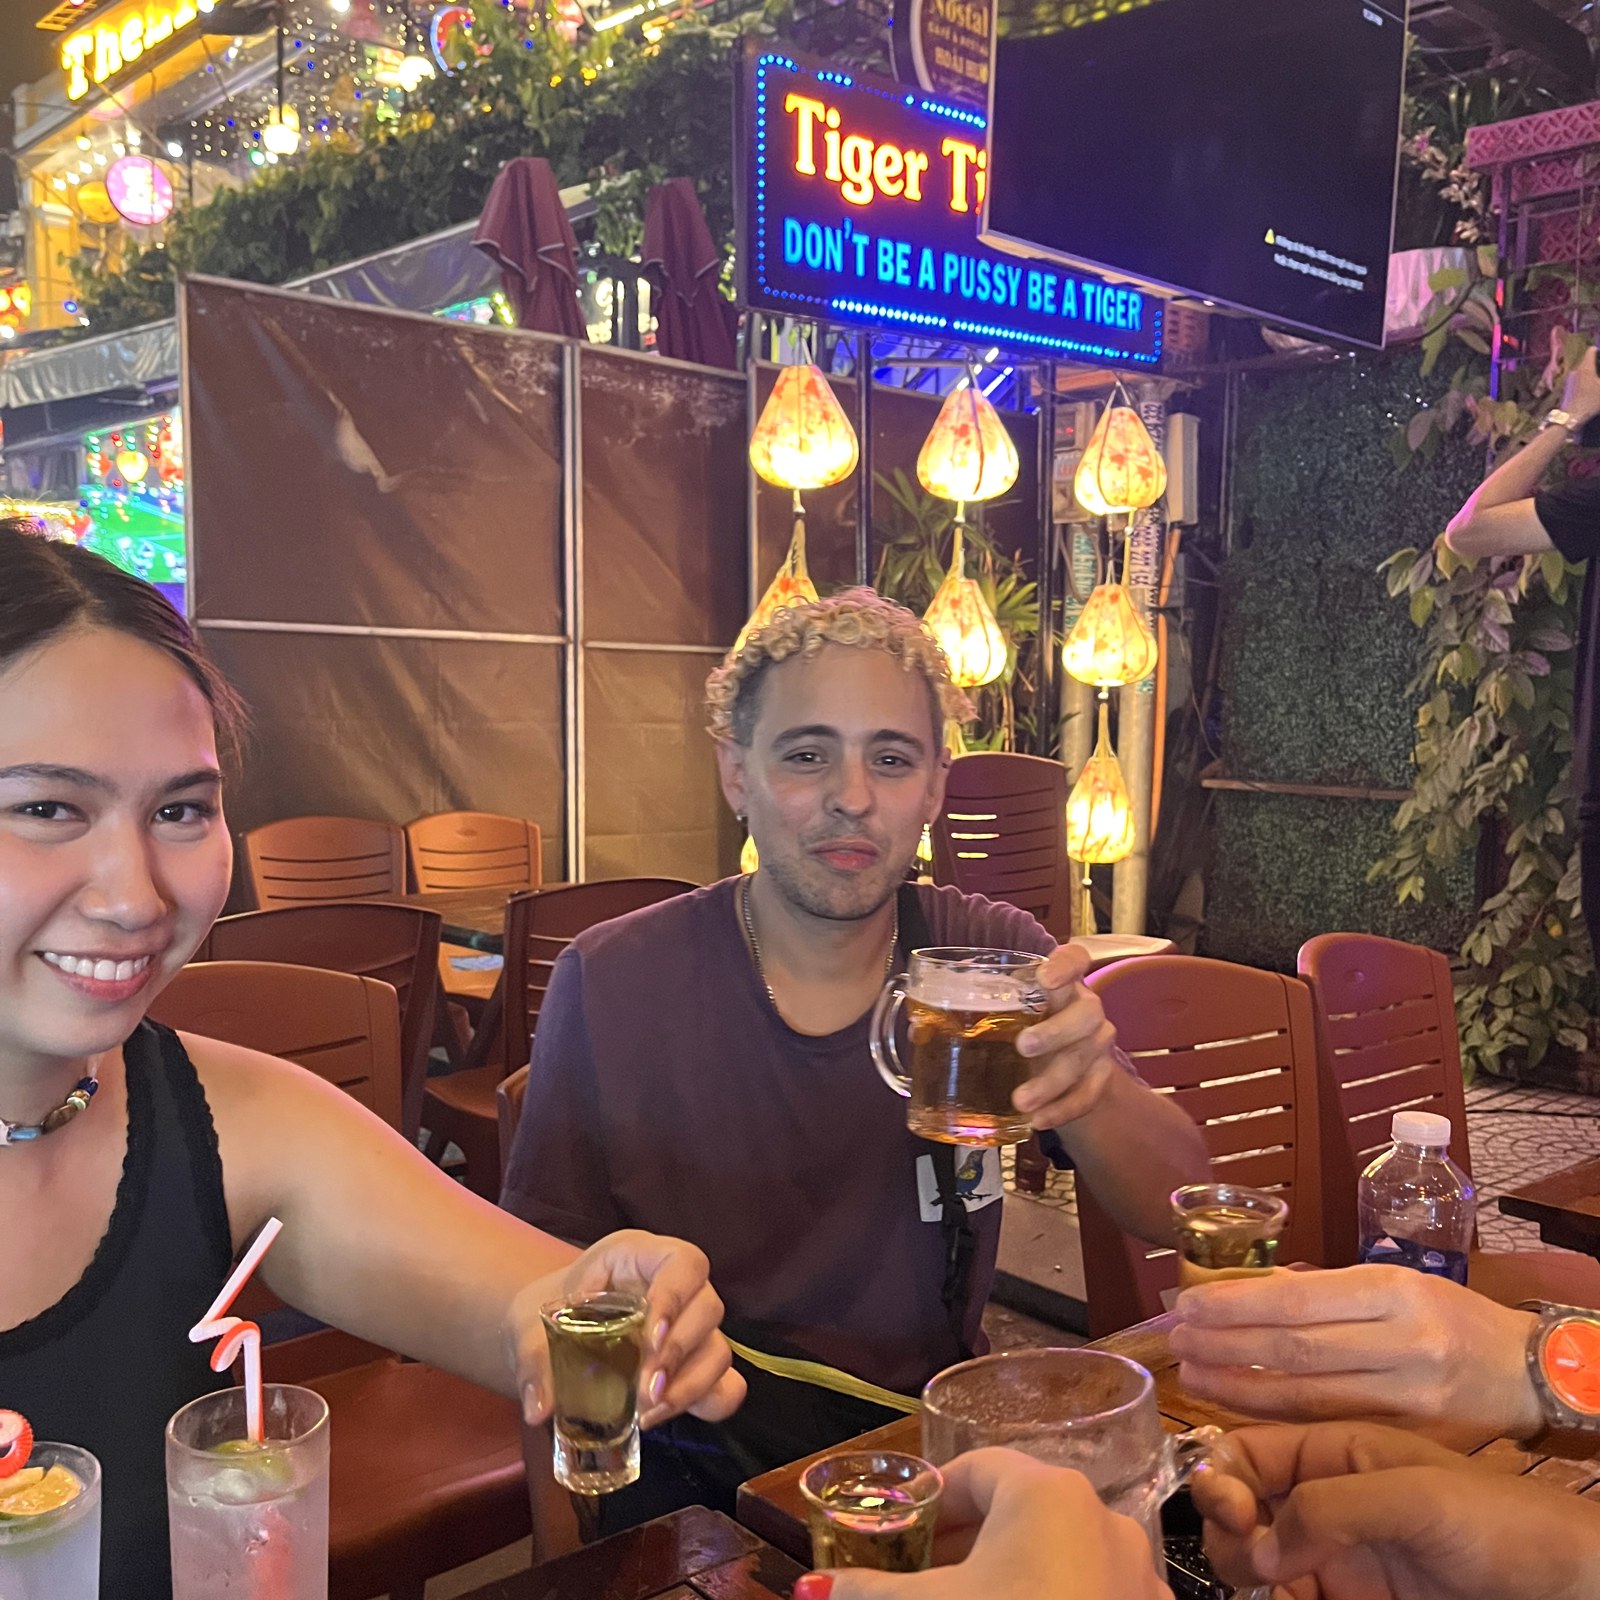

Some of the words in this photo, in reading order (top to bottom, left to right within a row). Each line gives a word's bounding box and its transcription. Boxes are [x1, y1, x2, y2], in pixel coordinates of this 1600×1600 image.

[61, 10, 145, 101] The
[784, 92, 929, 206] Tiger
[784, 216, 870, 277] DON'T
[877, 238, 912, 286] BE
[918, 247, 936, 291] A
[943, 252, 1022, 307] PUSSY
[1027, 269, 1058, 315] BE
[1062, 278, 1078, 319] A
[1081, 282, 1143, 332] TIGER
